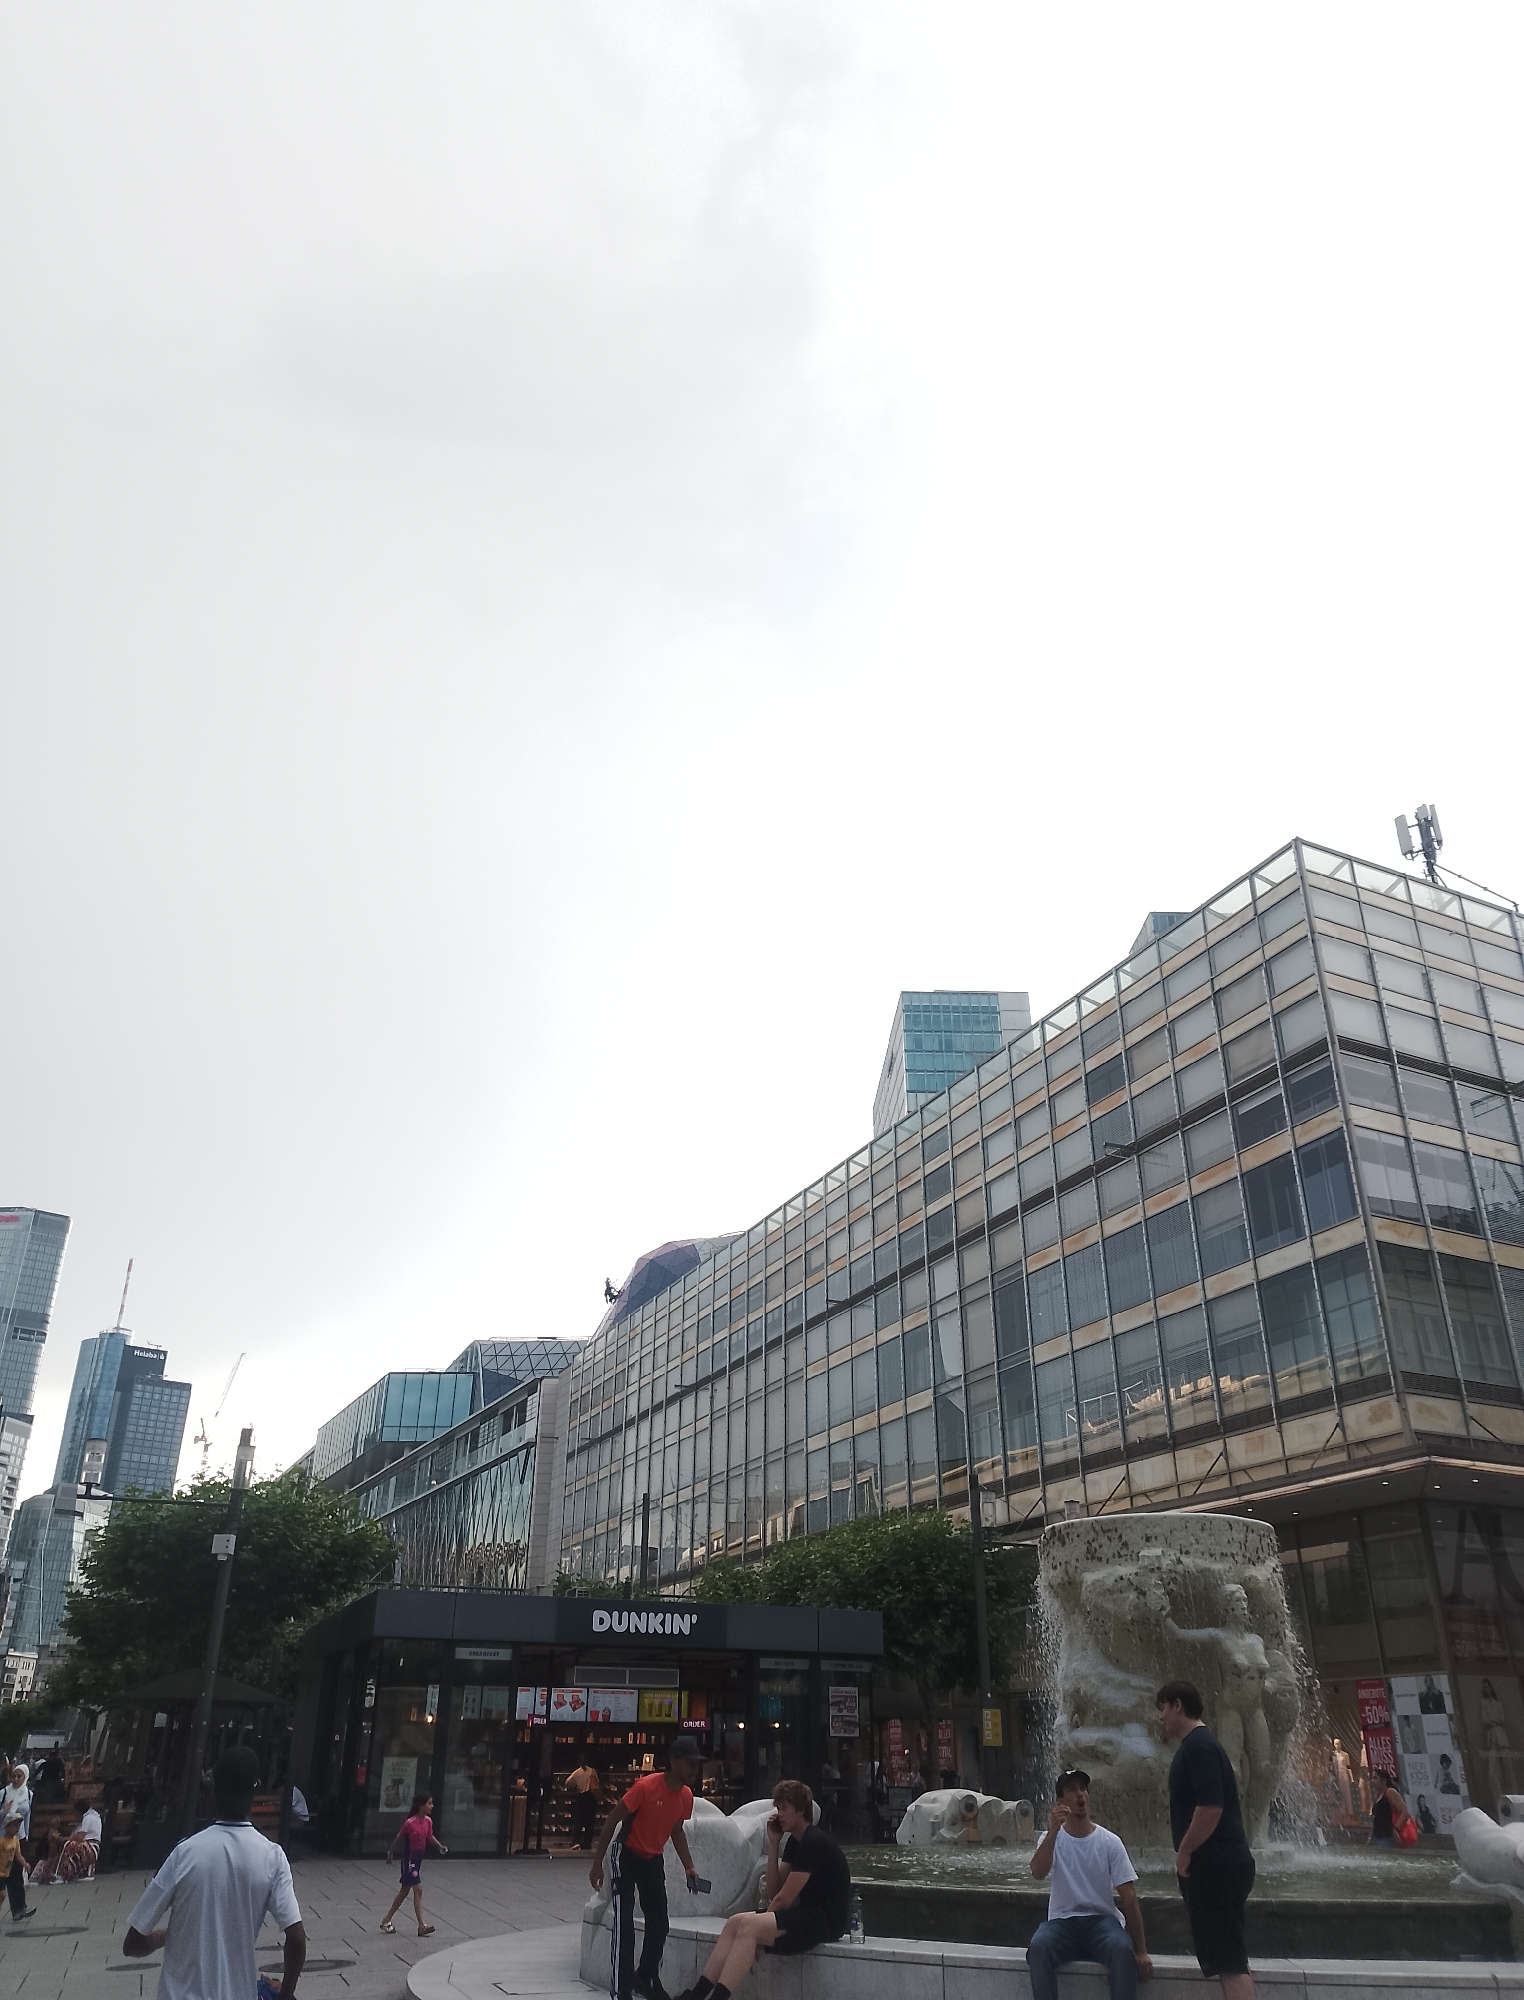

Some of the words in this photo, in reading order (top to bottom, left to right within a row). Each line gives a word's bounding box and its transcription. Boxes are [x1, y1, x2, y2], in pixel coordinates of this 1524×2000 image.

[134, 1349, 157, 1359] Helaba
[592, 1609, 697, 1635] DUNKIN'
[1358, 1687, 1386, 1699] ANGEBOTE
[1361, 1705, 1390, 1725] -50%
[683, 1720, 705, 1728] ORDER
[1368, 1736, 1392, 1750] ALLES
[1369, 1749, 1394, 1764] MUSS
[1410, 1770, 1429, 1781] KIDS
